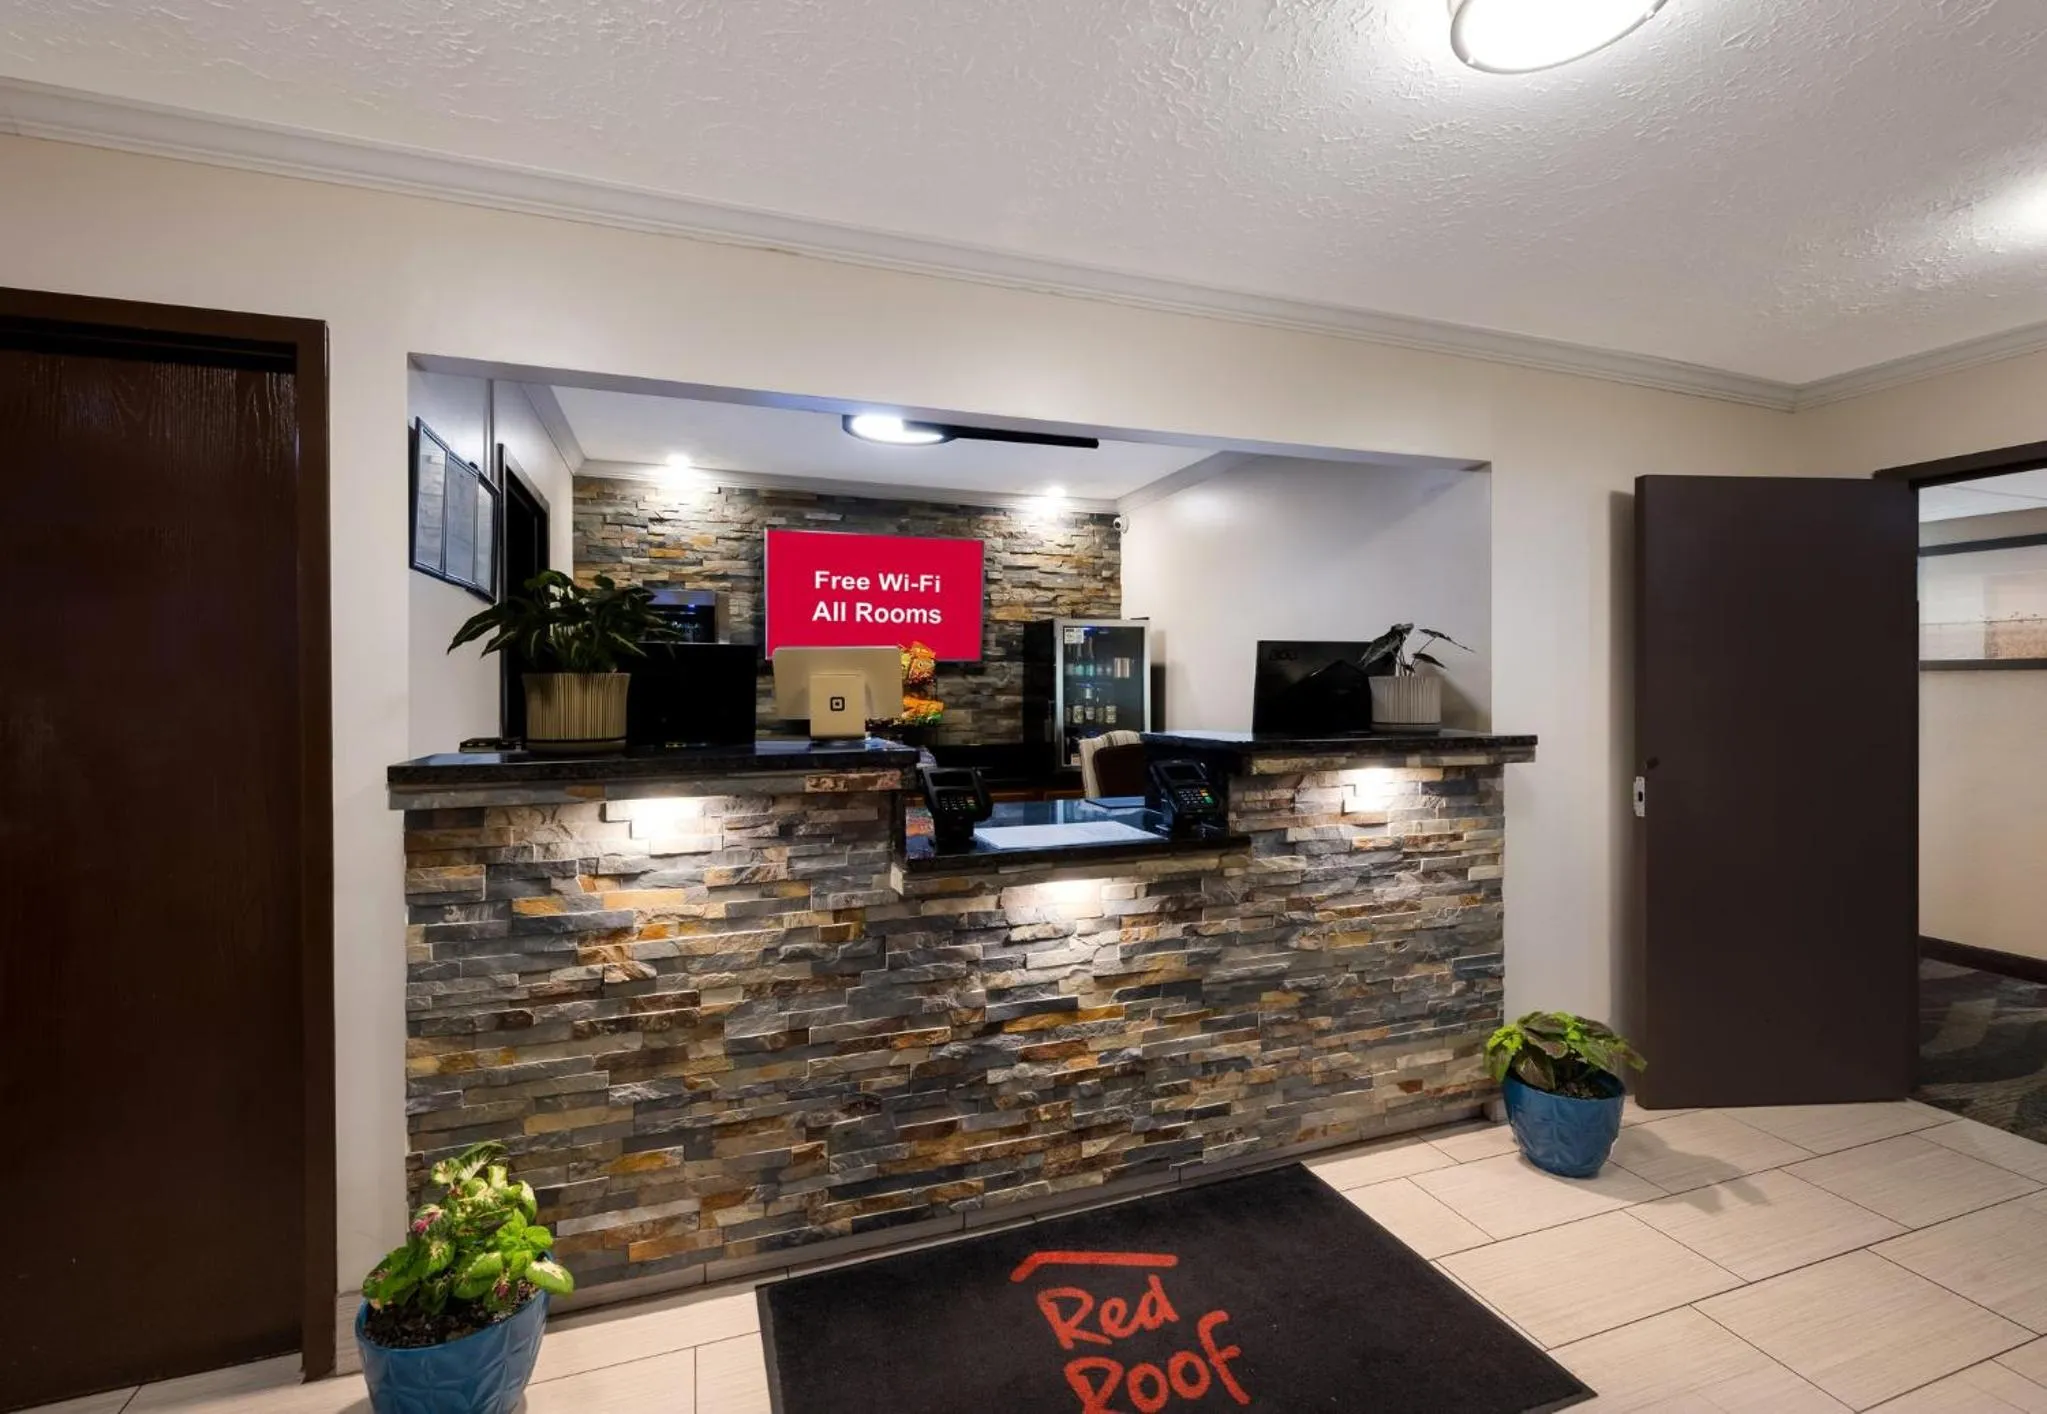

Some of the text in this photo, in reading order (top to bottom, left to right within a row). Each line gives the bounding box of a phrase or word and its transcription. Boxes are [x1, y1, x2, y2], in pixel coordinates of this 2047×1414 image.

[814, 571, 941, 593] Free Wi-Fi
[811, 601, 943, 625] All Rooms
[1037, 1273, 1180, 1350] Red
[1064, 1310, 1251, 1414] Roof
